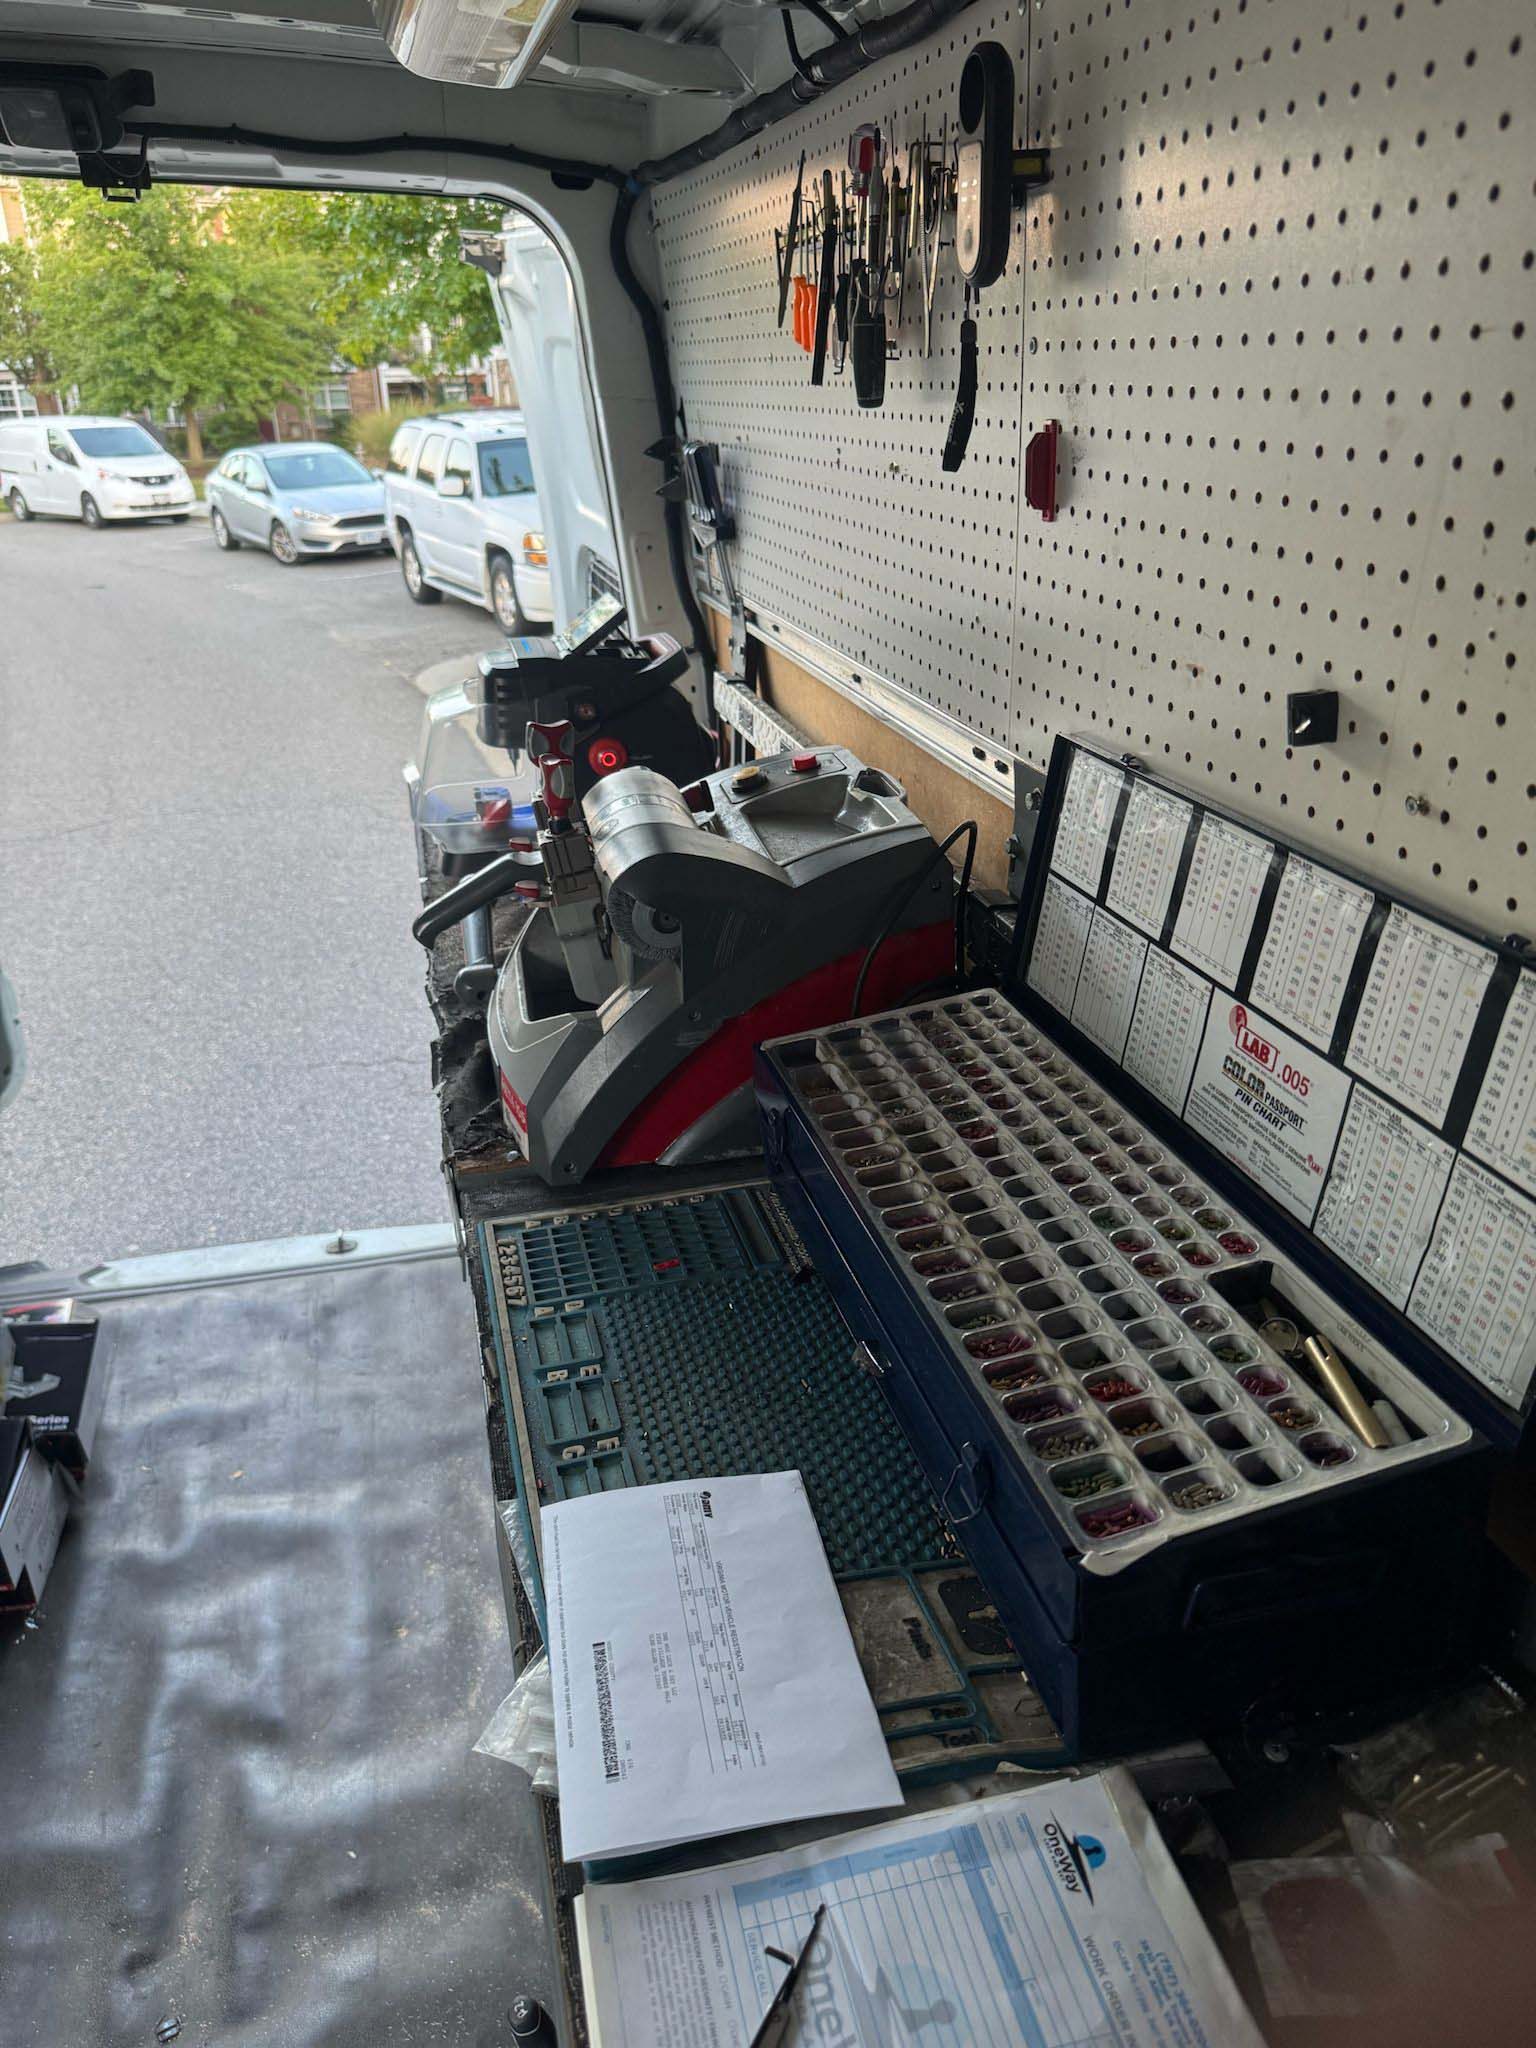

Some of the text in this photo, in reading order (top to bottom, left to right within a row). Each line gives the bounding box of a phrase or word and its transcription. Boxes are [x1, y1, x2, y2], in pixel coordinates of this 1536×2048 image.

[1242, 1031, 1270, 1064] LAB
[1223, 1055, 1266, 1099] COLOR
[1264, 1092, 1305, 1129] PASSPORT
[1277, 1063, 1311, 1097] .005
[1235, 1088, 1251, 1107] PIN
[1254, 1103, 1287, 1131] CHART
[547, 1369, 568, 1382] B
[580, 1364, 600, 1378] E
[562, 1445, 585, 1460] C
[1044, 1824, 1082, 1892] OneWay
[1083, 1935, 1109, 1979] WORK
[1102, 1979, 1132, 2032] ORDER
